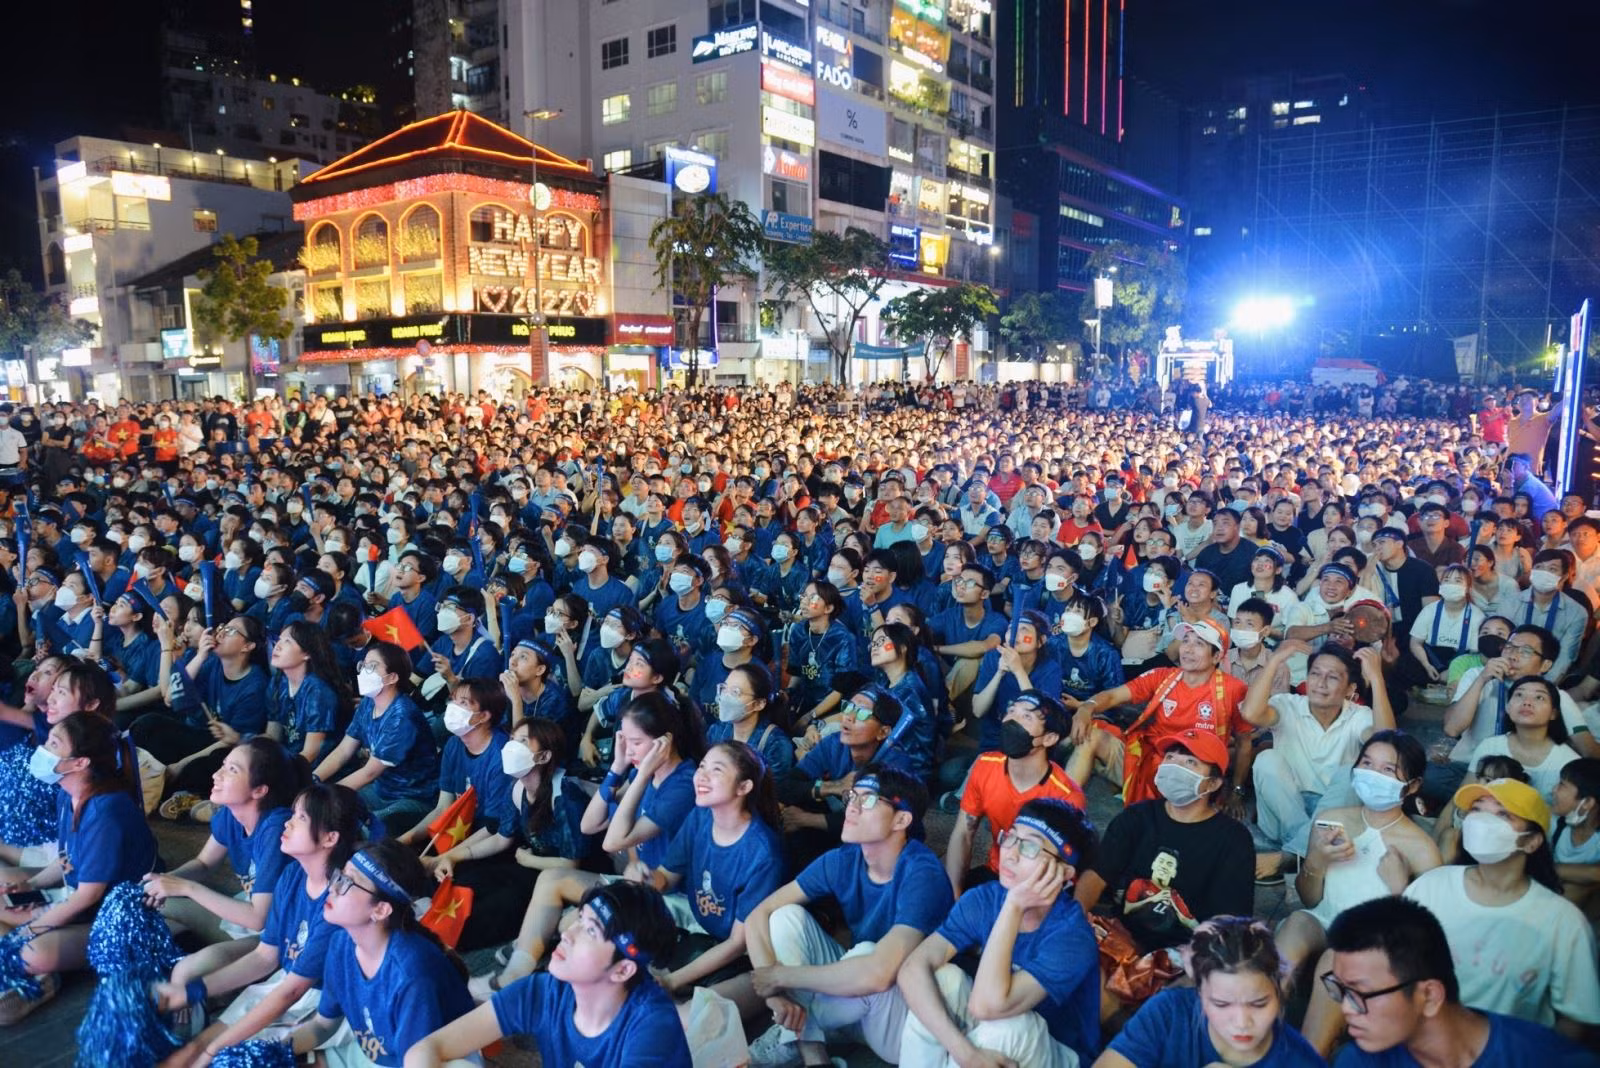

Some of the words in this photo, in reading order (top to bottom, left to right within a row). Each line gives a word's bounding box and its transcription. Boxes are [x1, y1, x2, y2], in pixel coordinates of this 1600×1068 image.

[817, 60, 852, 90] FADO
[493, 211, 582, 248] HAPPY
[781, 217, 813, 235] Expertise
[469, 246, 530, 277] NEW
[536, 250, 600, 284] YEAR
[511, 286, 575, 316] 2022
[801, 664, 819, 680] Tige
[704, 702, 720, 719] Tig
[1194, 721, 1215, 730] mitre
[695, 888, 726, 917] iger
